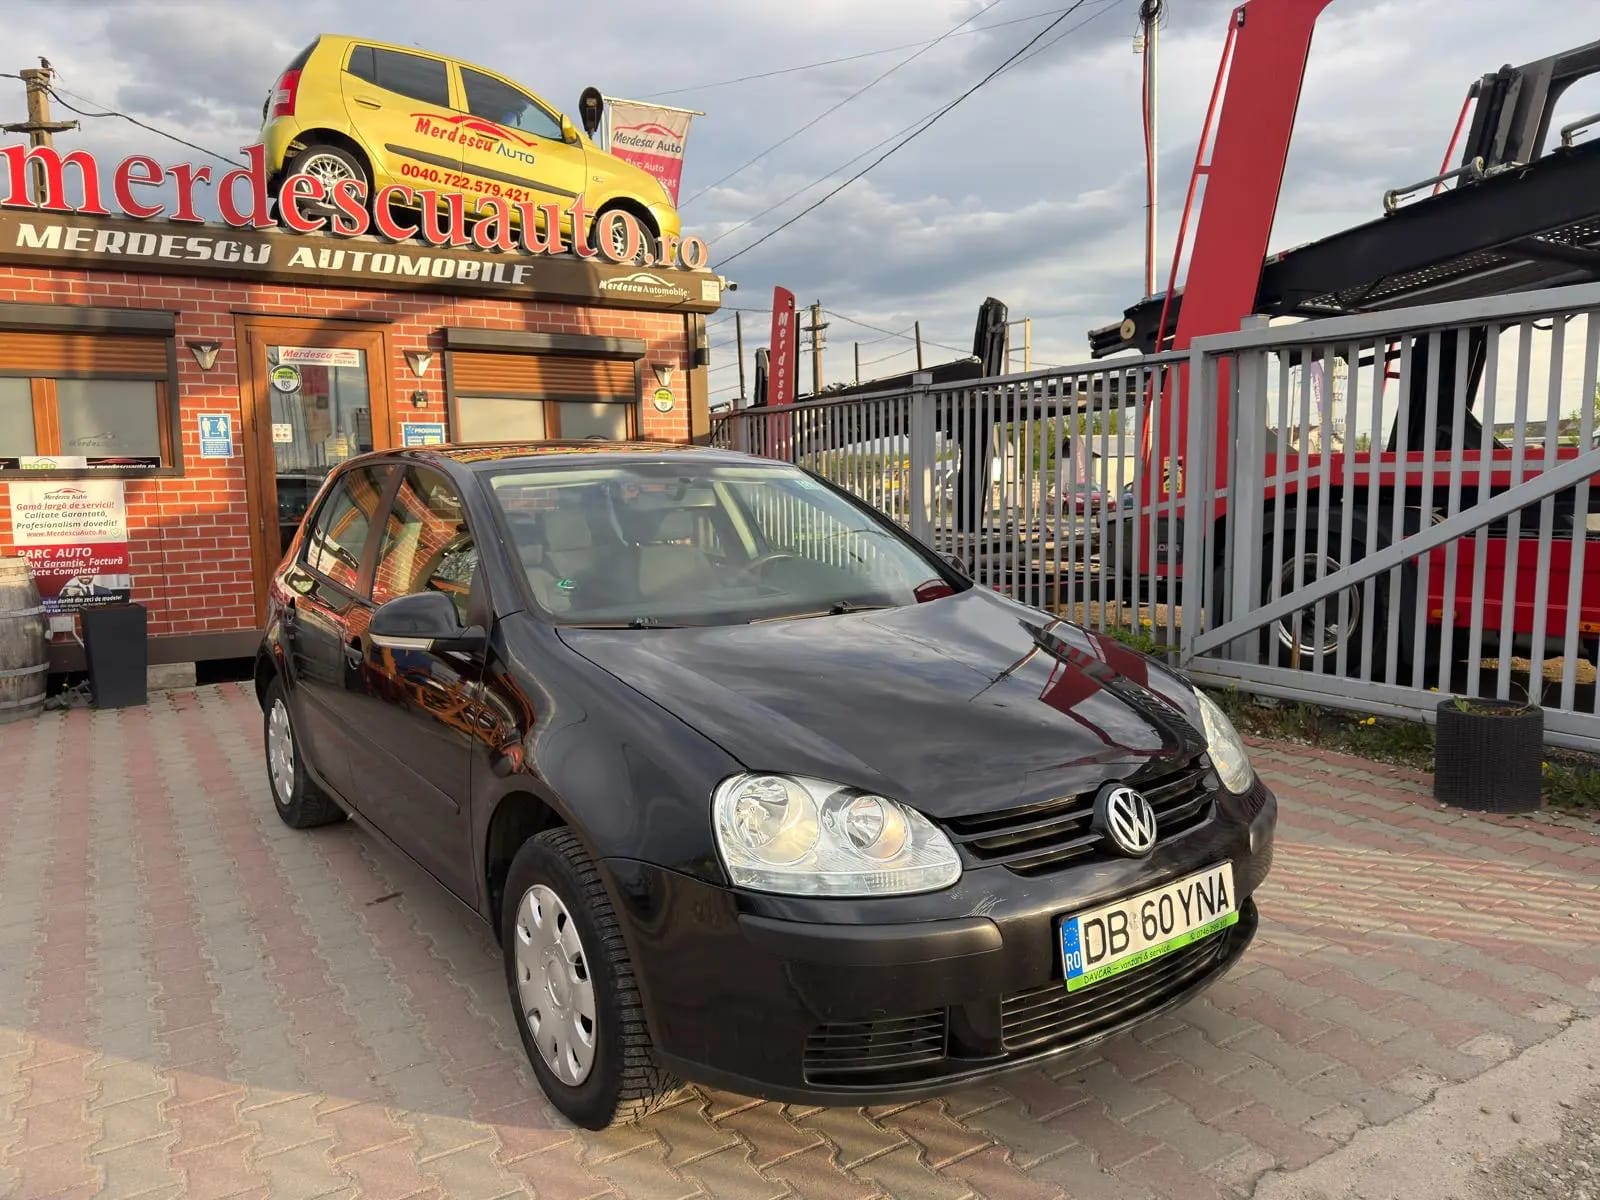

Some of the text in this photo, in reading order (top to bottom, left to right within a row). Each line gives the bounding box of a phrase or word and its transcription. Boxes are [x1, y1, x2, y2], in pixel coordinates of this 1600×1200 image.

[415, 117, 535, 165] Merdescu AUTO
[613, 131, 682, 154] Merdescu Auto
[643, 161, 664, 173] Auto
[401, 163, 530, 202] 0040.722.579.421
[0, 142, 708, 269] merdescuauto.ro
[288, 247, 535, 286] AUTOMOBILE
[283, 349, 333, 359] Merdescu
[777, 311, 789, 406] Merdesc
[69, 502, 80, 510] de
[82, 501, 115, 509] servicii!
[16, 519, 118, 530] Profesionalism dovedit!
[56, 547, 92, 558] AUTO
[89, 556, 123, 566] Factură
[31, 566, 100, 577] Acte Complete!
[1084, 871, 1230, 966] DB 60 YNA
[1149, 944, 1171, 958] service
[1066, 950, 1081, 972] RO
